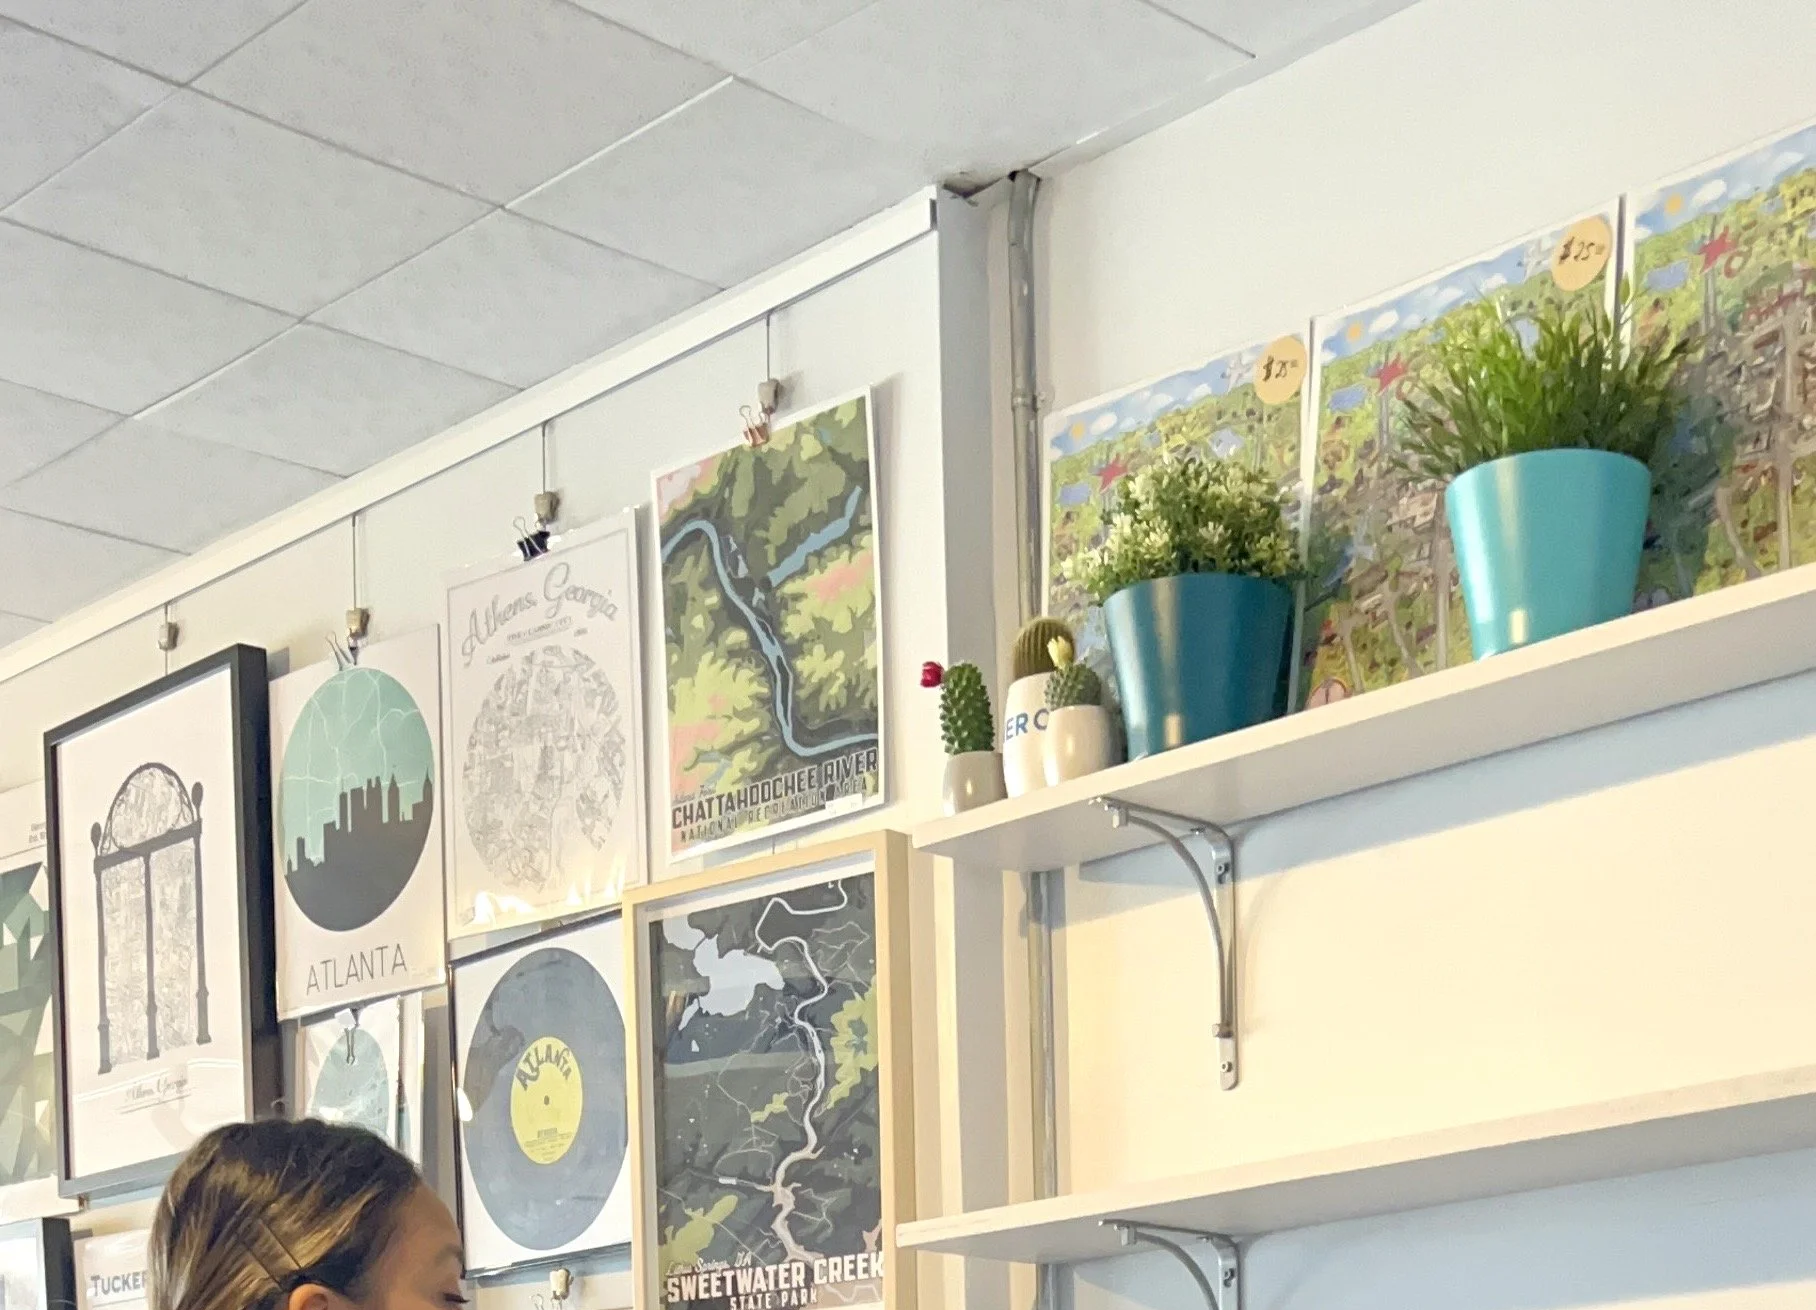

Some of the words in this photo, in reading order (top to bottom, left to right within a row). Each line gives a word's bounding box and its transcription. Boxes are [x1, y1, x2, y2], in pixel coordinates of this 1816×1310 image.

[672, 767, 816, 830] CHATTAHOOCHEE
[824, 748, 878, 787] RIVER
[681, 814, 739, 843] NATIONAL
[306, 943, 408, 996] ATLANTA
[516, 1043, 572, 1091] ATLANTA
[667, 1261, 806, 1303] SWEETWATER
[814, 1250, 884, 1285] CREEK
[782, 1288, 817, 1308] PARK
